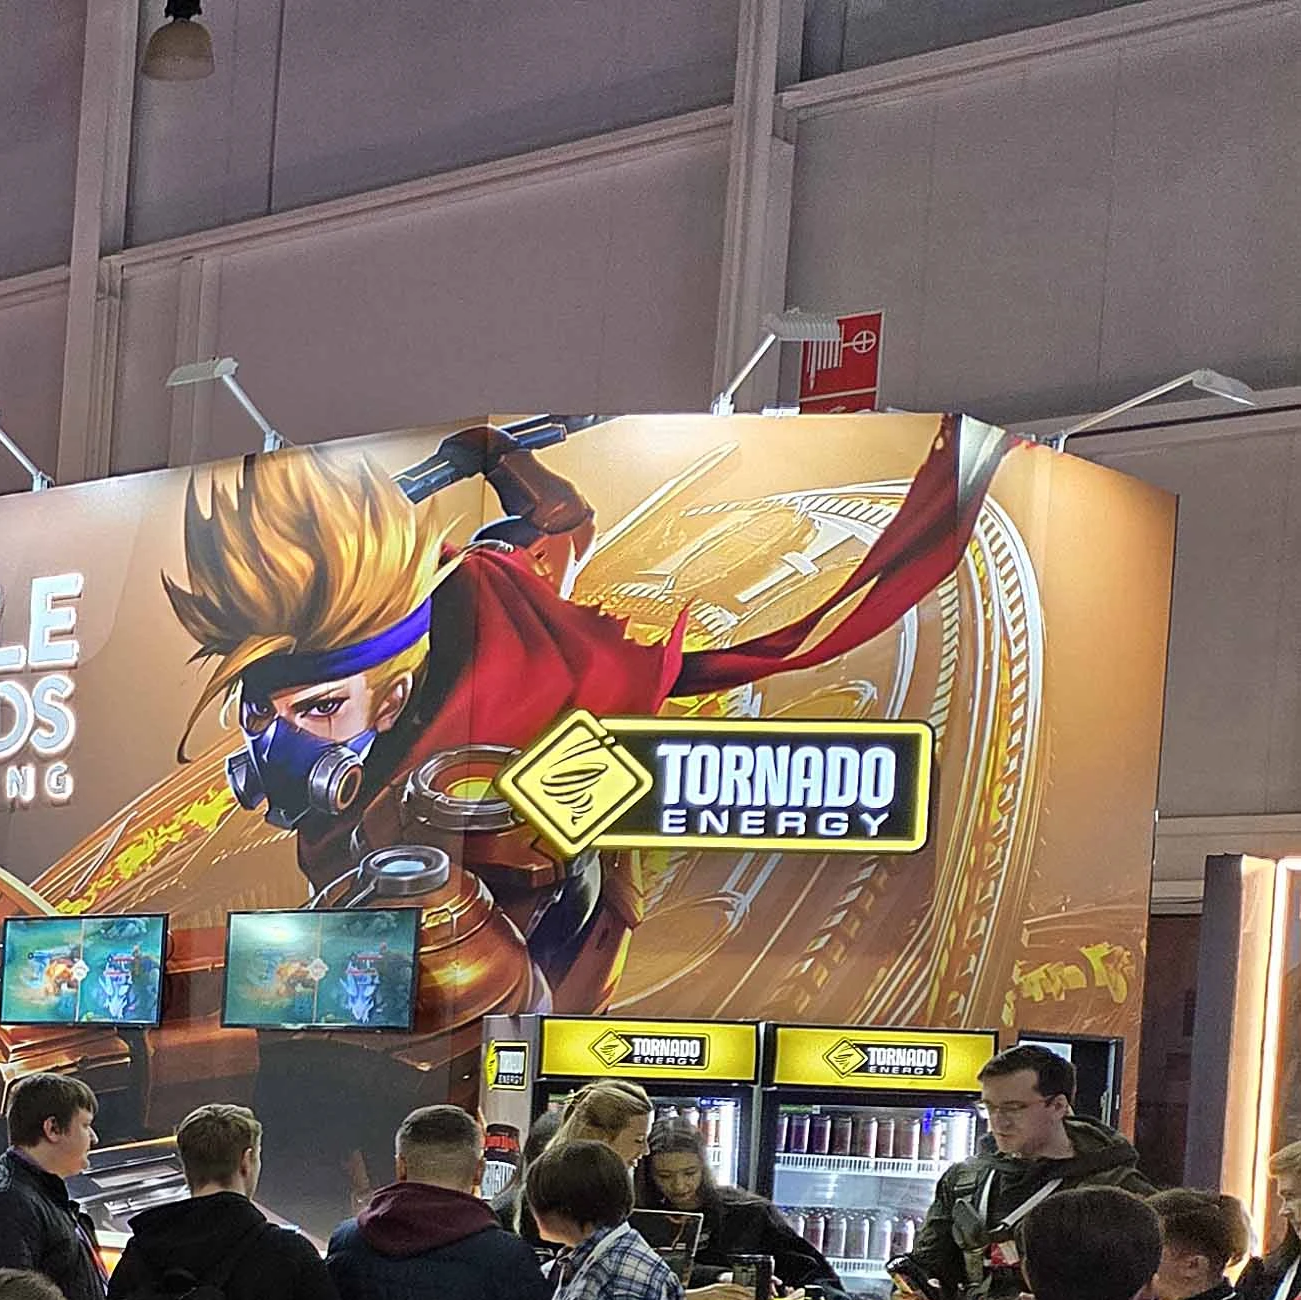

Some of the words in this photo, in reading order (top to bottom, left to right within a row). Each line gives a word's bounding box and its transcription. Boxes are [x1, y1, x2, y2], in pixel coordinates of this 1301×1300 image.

[656, 742, 897, 809] TORNADO
[661, 809, 891, 837] ENERGY
[632, 1037, 700, 1058] TORNADO
[868, 1047, 939, 1068] TORNADO
[633, 1056, 700, 1065] ENERGY
[869, 1066, 936, 1075] ENERGY
